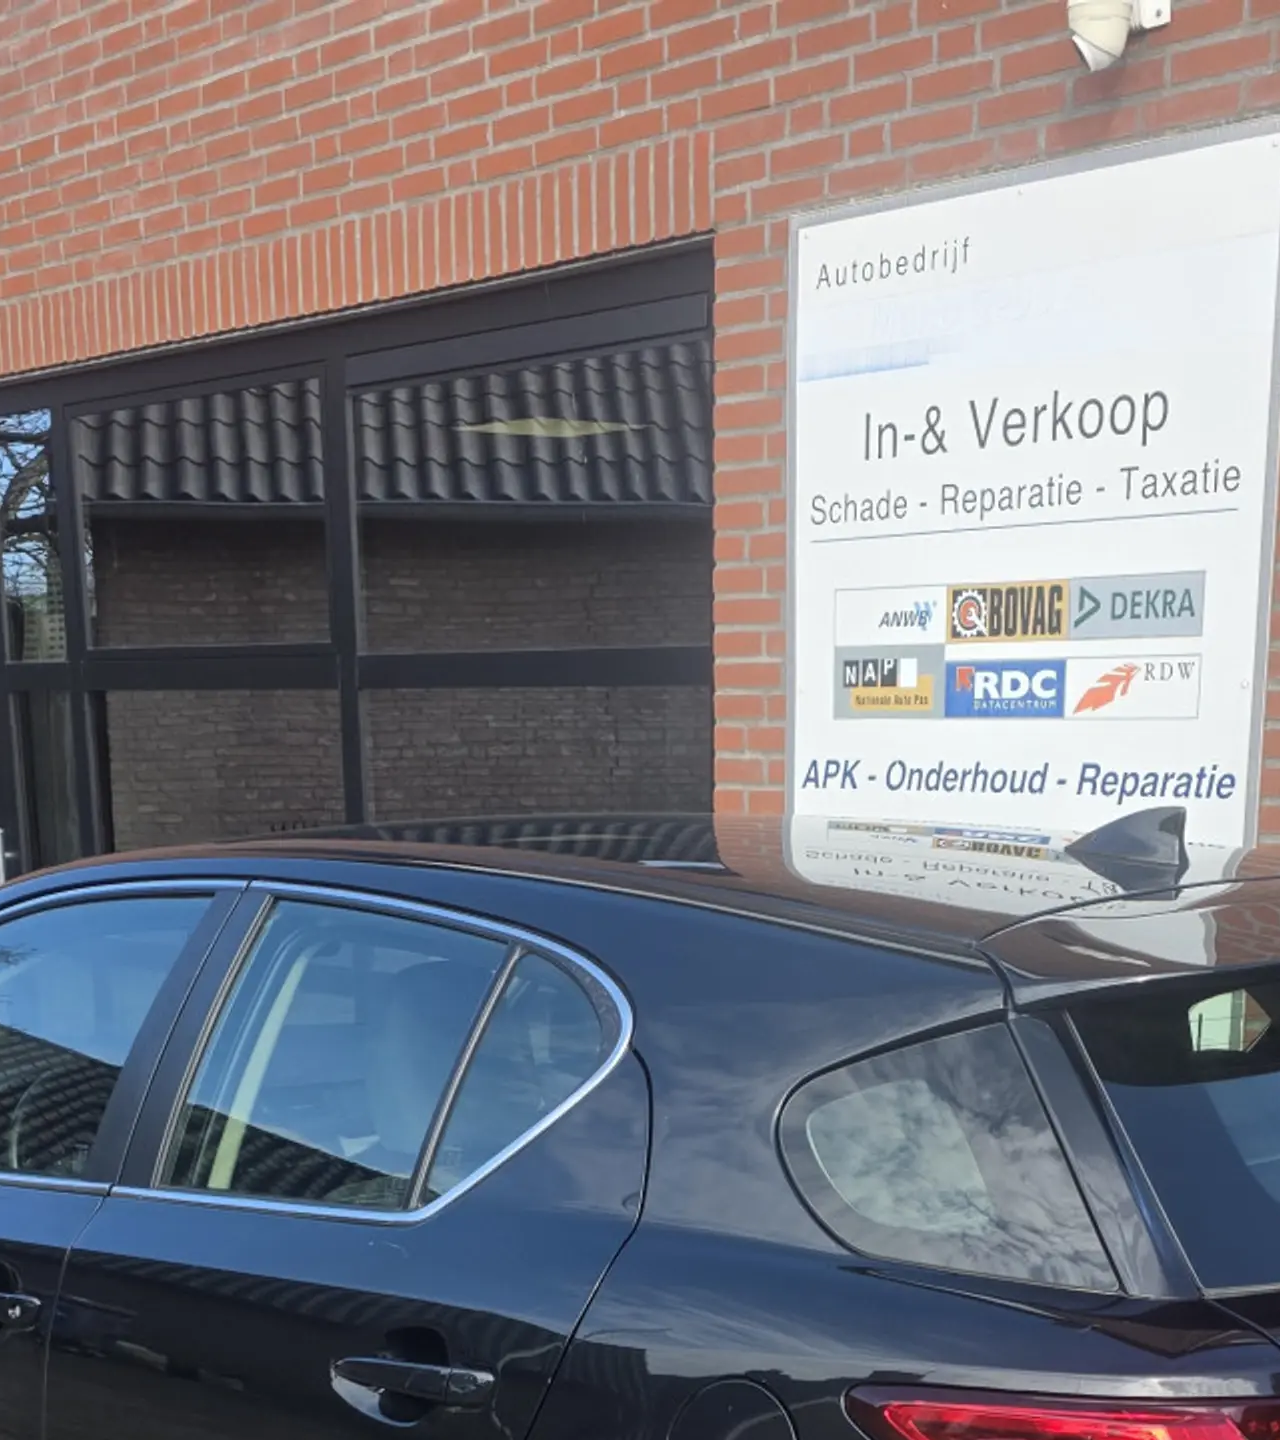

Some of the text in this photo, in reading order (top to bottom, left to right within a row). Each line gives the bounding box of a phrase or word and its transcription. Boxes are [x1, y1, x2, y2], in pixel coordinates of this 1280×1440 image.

[816, 236, 971, 290] Autobedrijf
[864, 388, 1170, 462] In-& Verkoop
[811, 488, 909, 526] Schade
[939, 474, 1083, 520] Reparatie
[1120, 458, 1241, 501] Taxatie
[878, 609, 928, 628] ANWB
[988, 584, 1064, 637] BOVAG
[1110, 588, 1196, 621] DEKRA
[845, 659, 895, 685] NAP
[973, 668, 1058, 700] RDC
[972, 700, 1058, 711] DATACENTRUM
[801, 760, 862, 790] APK
[885, 760, 1051, 796] Onderhoud
[1076, 763, 1237, 805] Reparatie
